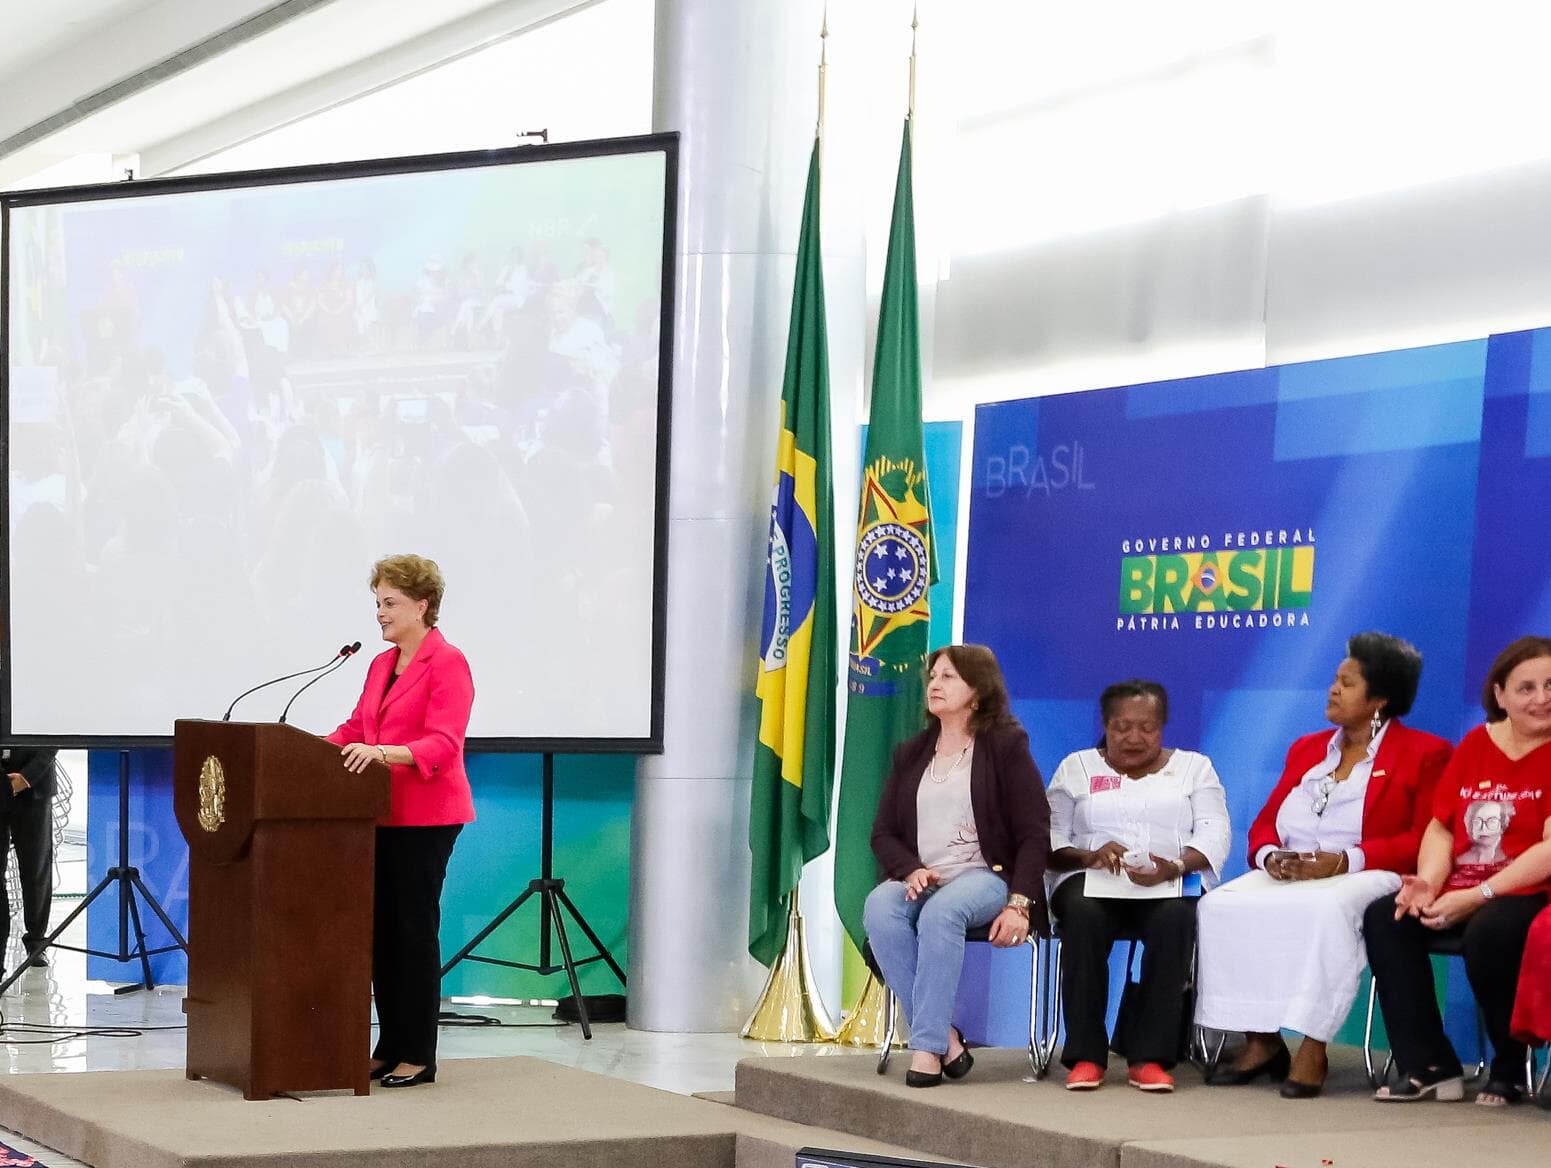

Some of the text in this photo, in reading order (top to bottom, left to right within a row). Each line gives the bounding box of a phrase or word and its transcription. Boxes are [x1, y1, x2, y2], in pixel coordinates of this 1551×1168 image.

[985, 441, 1095, 499] BRASIL
[1121, 528, 1317, 553] GOVERNO FEDERAL
[1119, 545, 1315, 614] BRASIL
[1116, 611, 1311, 631] PÁTRIA EDUCADORA
